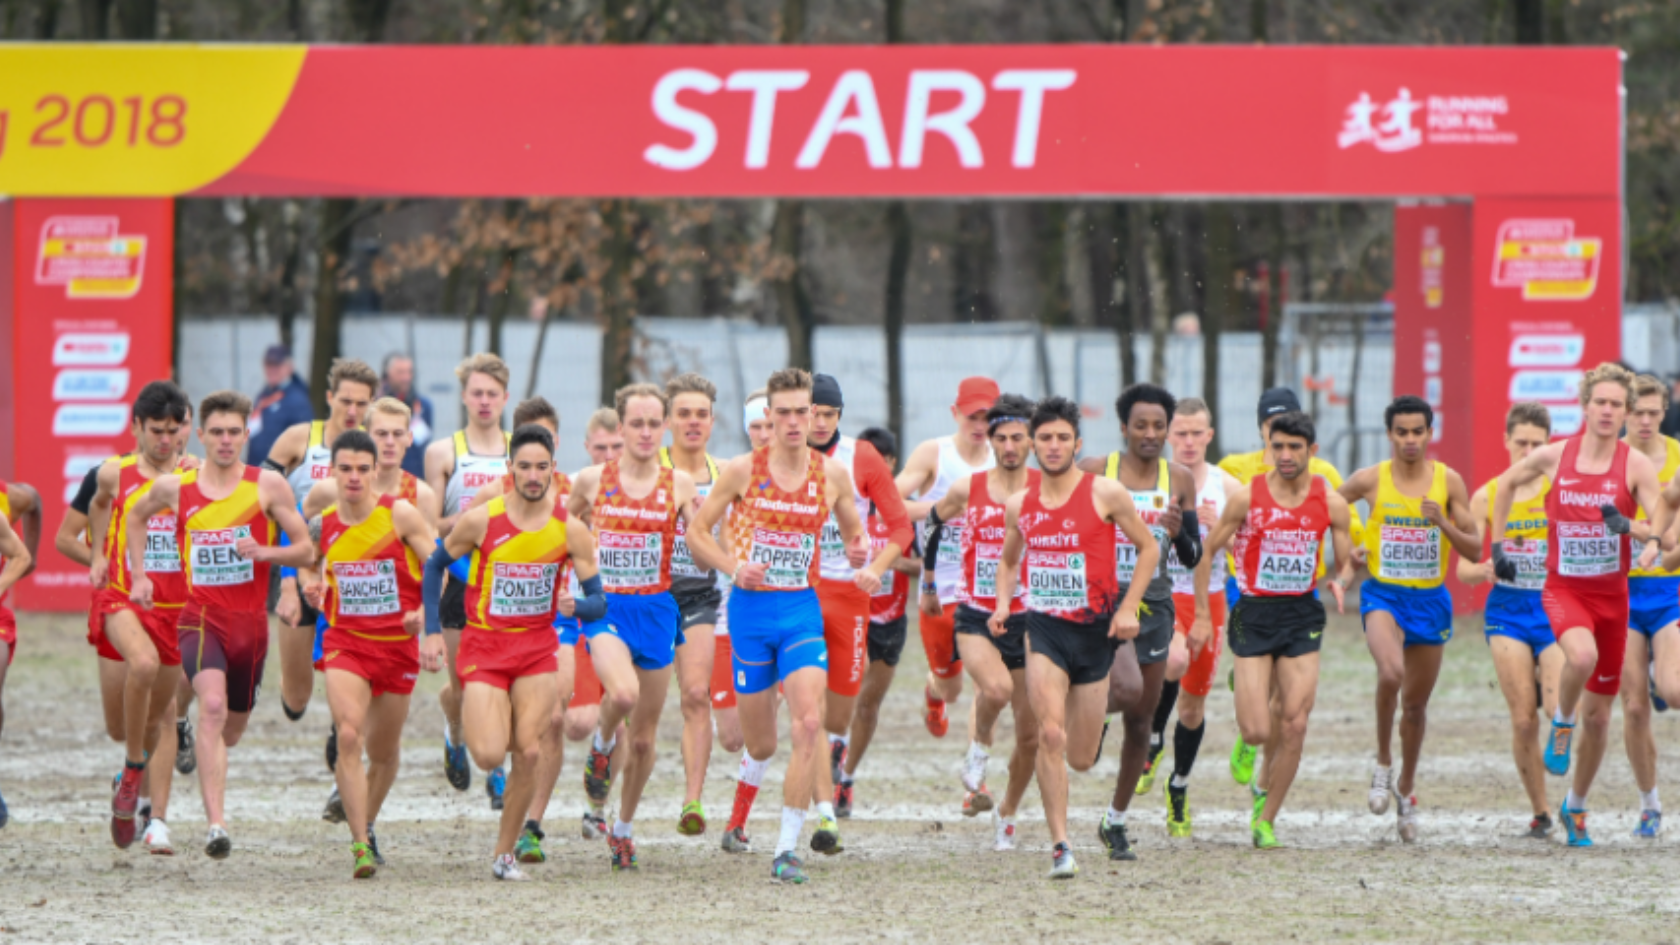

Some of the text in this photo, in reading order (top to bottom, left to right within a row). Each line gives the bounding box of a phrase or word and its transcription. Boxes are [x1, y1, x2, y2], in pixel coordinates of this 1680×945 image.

[29, 92, 189, 149] 2018
[643, 68, 1077, 171] START
[1560, 489, 1616, 507] DANMARK
[1384, 515, 1431, 527] SWEDE
[1558, 522, 1604, 537] SPAR
[979, 526, 1004, 540] TÜR
[1382, 527, 1426, 542] SPAR
[752, 545, 811, 569] FOPPEN
[1382, 545, 1438, 561] GERGIS
[1561, 540, 1617, 557] JENSEN
[600, 550, 659, 568] NIESTEN
[1029, 552, 1067, 567] SPAR
[1262, 555, 1314, 574] ARAS
[495, 565, 542, 578] SPAR
[1031, 571, 1083, 590] GÜNEN
[340, 577, 394, 598] SANCHEZ
[494, 578, 552, 598] FONTES
[850, 616, 864, 683] POLSKA
